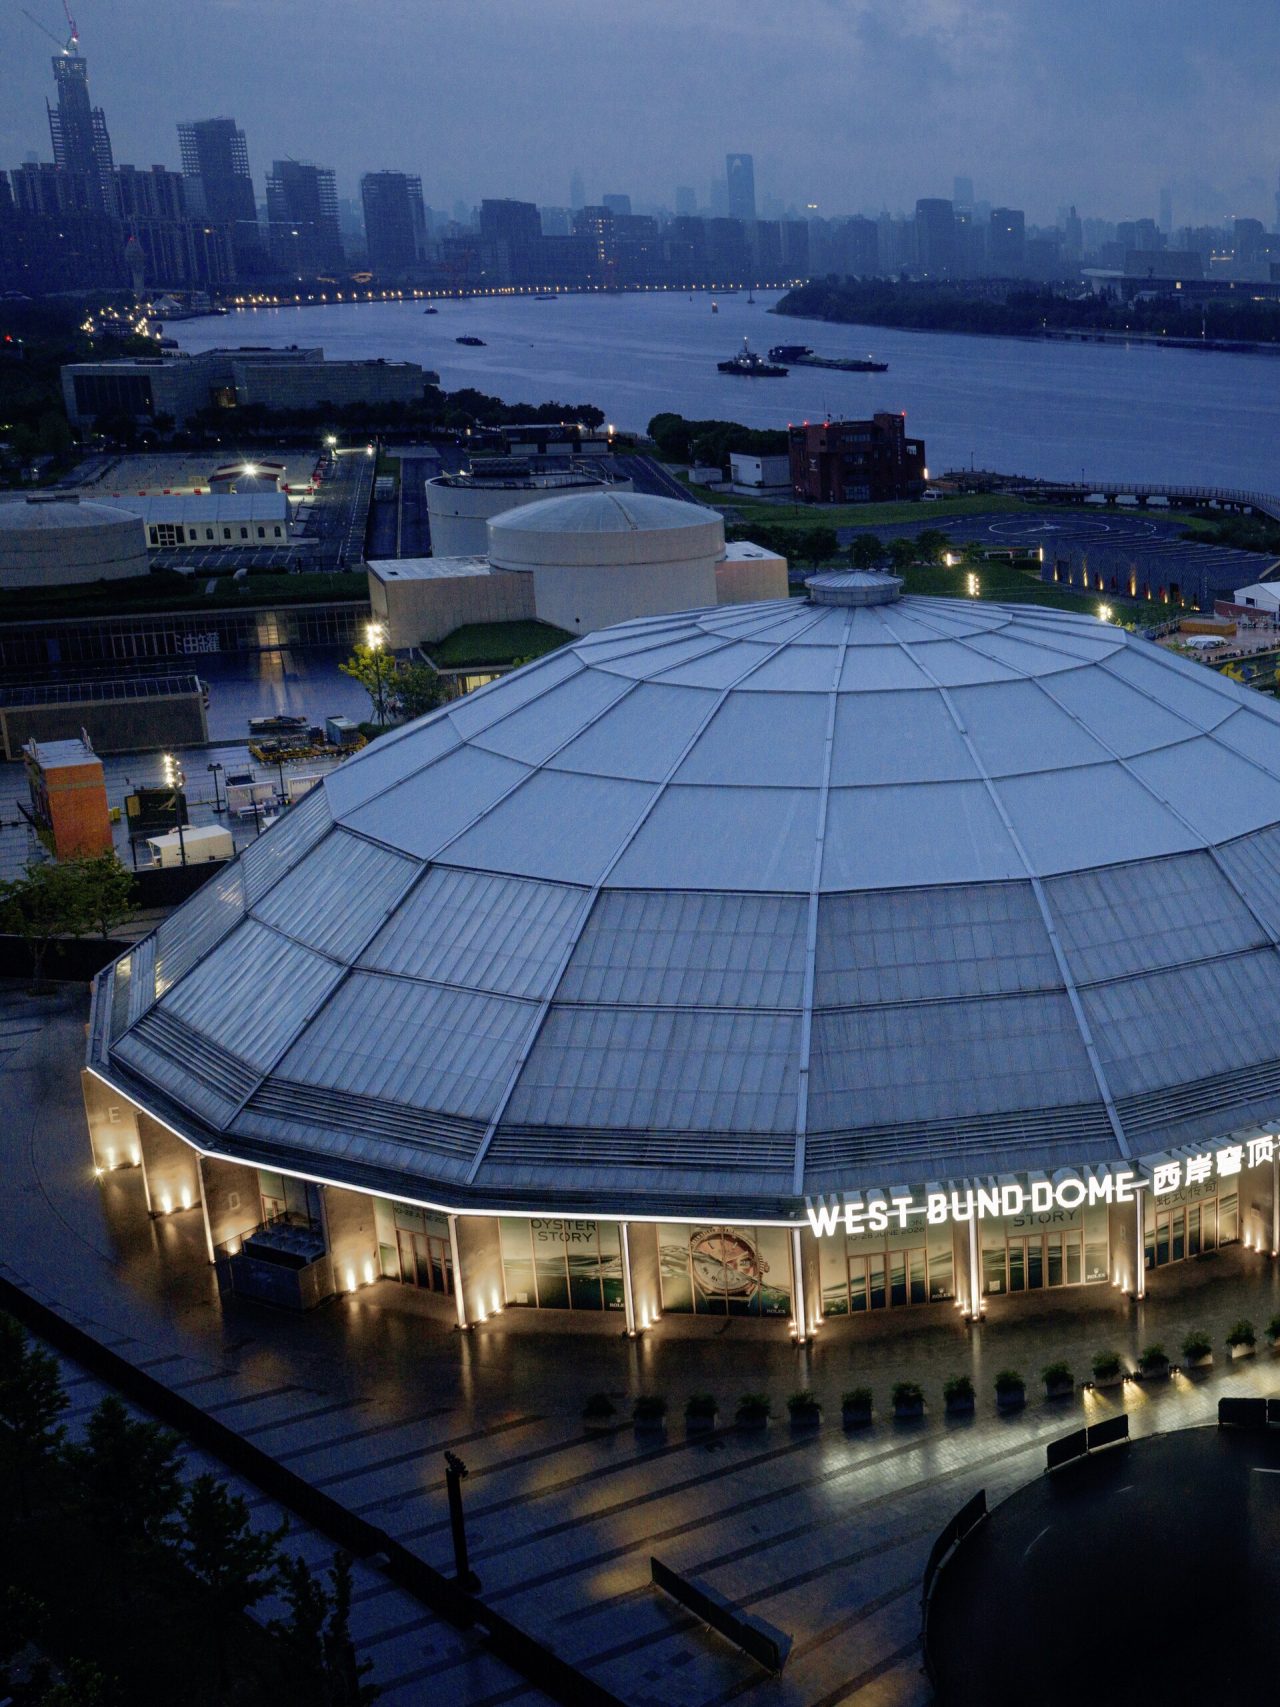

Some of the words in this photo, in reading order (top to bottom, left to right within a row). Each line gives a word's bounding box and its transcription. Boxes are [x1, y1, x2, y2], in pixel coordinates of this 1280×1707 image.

[806, 1196, 914, 1238] WEST
[926, 1184, 1024, 1226] BUND
[1031, 1171, 1135, 1213] DOME
[531, 1218, 597, 1231] OYSTER
[1013, 1209, 1078, 1228] STORY
[538, 1231, 592, 1242] STORY
